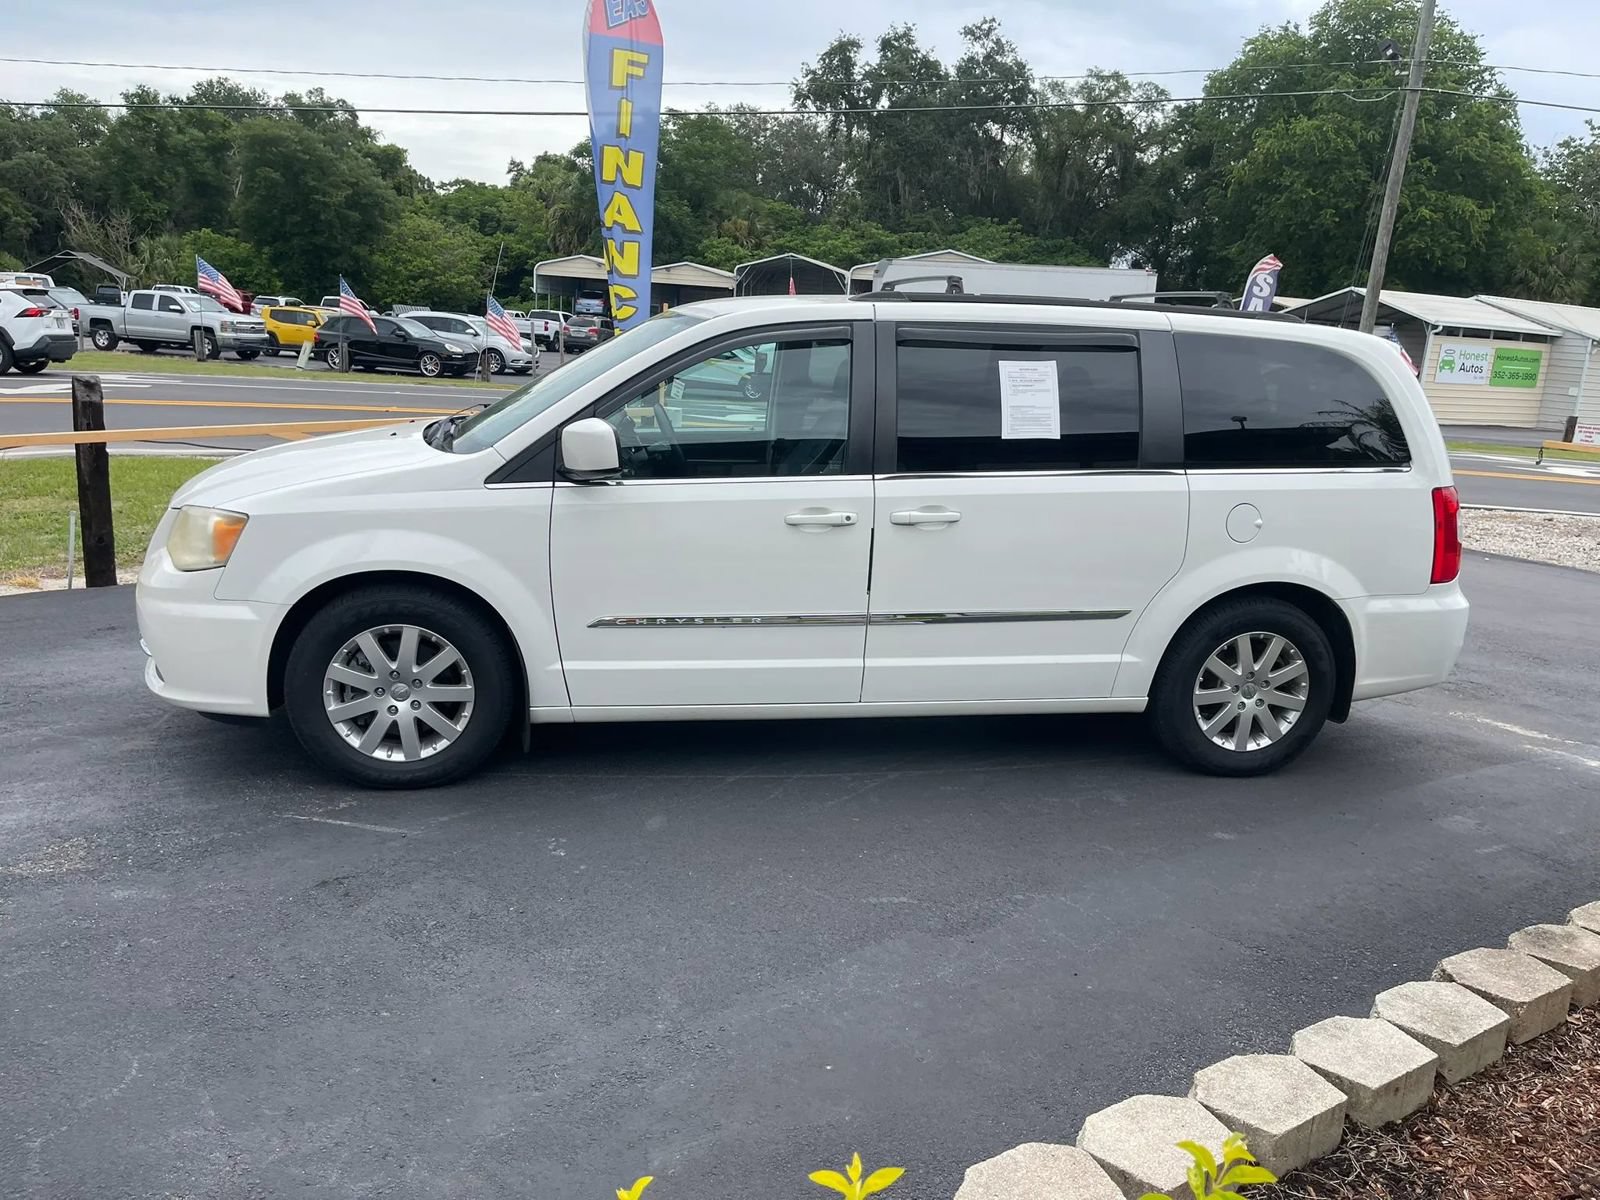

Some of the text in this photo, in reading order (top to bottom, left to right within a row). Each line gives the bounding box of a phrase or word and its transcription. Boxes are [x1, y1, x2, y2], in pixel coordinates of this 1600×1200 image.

[602, 48, 649, 335] FINANC
[1458, 350, 1489, 361] Honest
[1458, 362, 1484, 374] Autos
[1492, 370, 1537, 381] 352-365-1990
[615, 617, 762, 625] CHRYSLER
